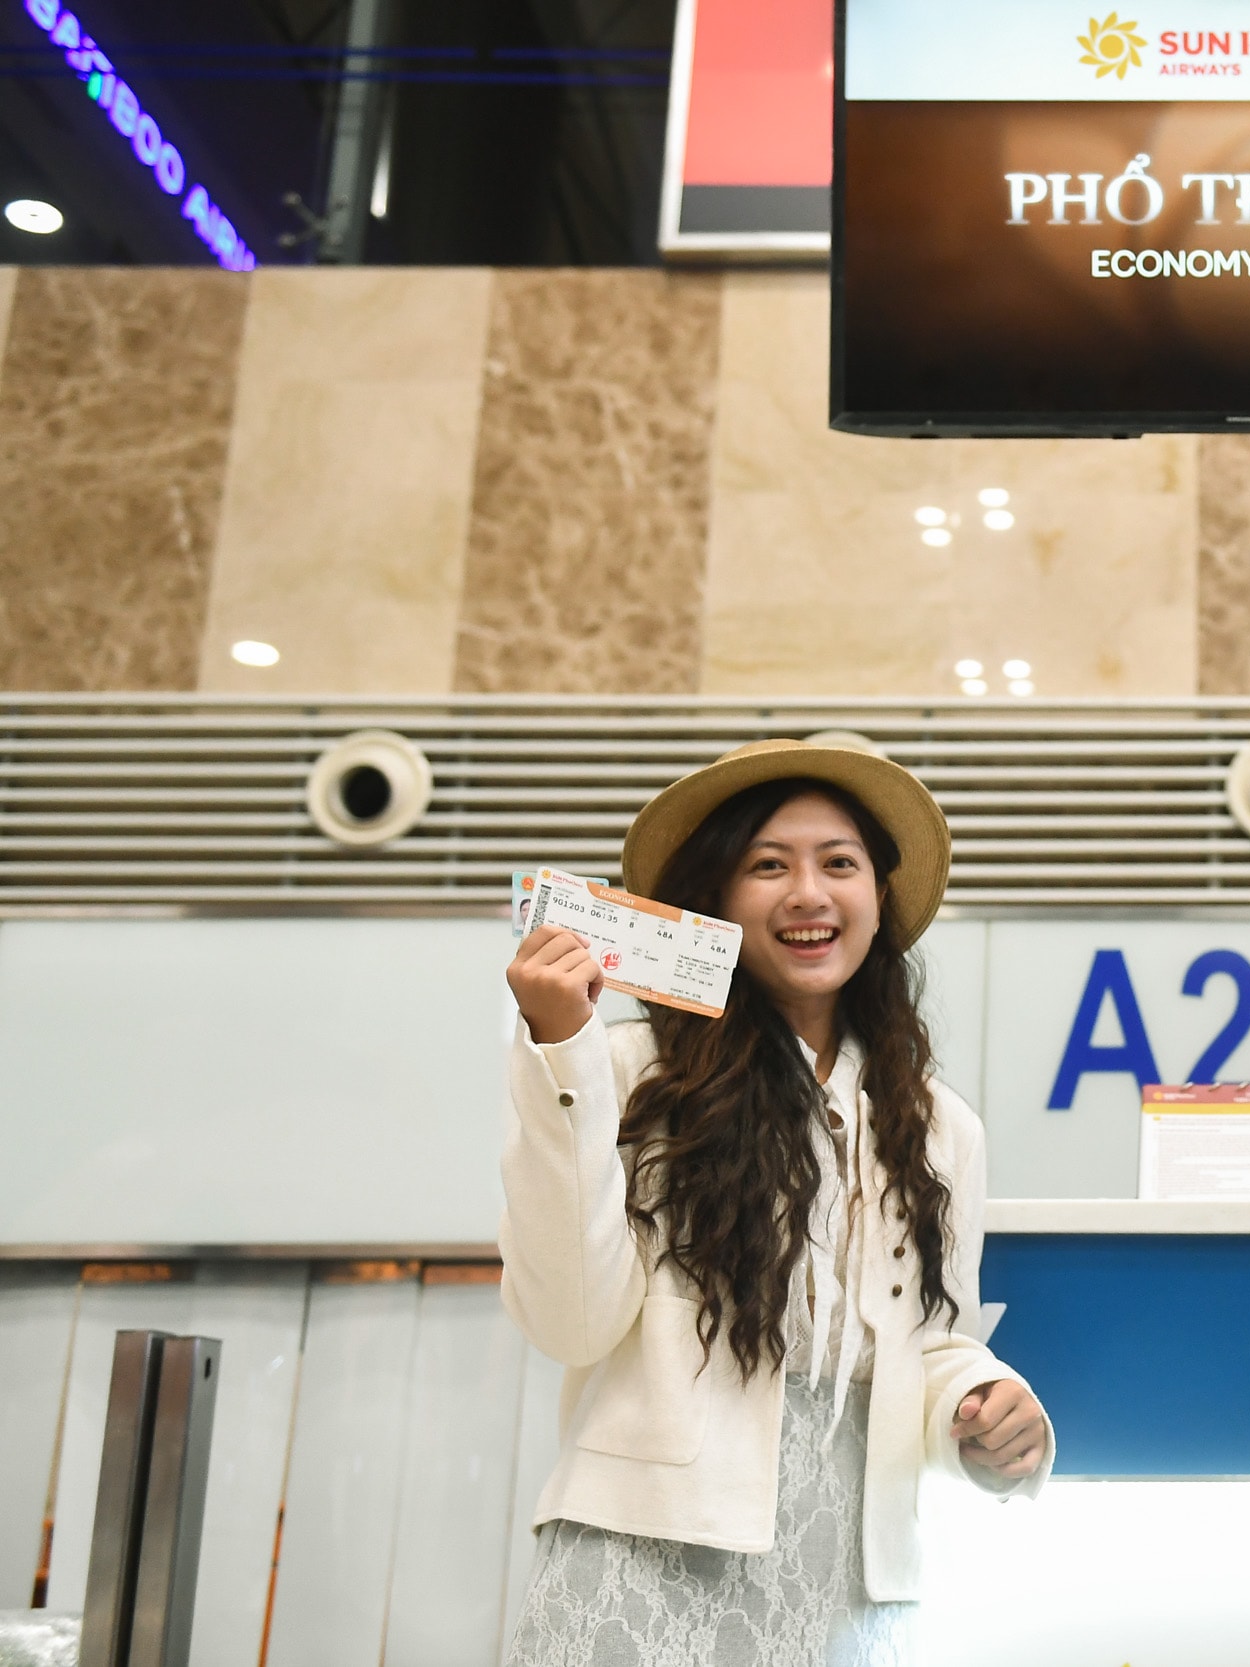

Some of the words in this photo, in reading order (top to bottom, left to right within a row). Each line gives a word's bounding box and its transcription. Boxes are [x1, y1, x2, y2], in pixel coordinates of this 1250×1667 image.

[1159, 31, 1231, 56] SUN
[1159, 63, 1242, 76] AIRWAYS
[1004, 153, 1164, 226] PHỔ
[599, 889, 636, 906] ECONOMY
[590, 909, 618, 923] 06:35
[656, 929, 673, 940] 48A
